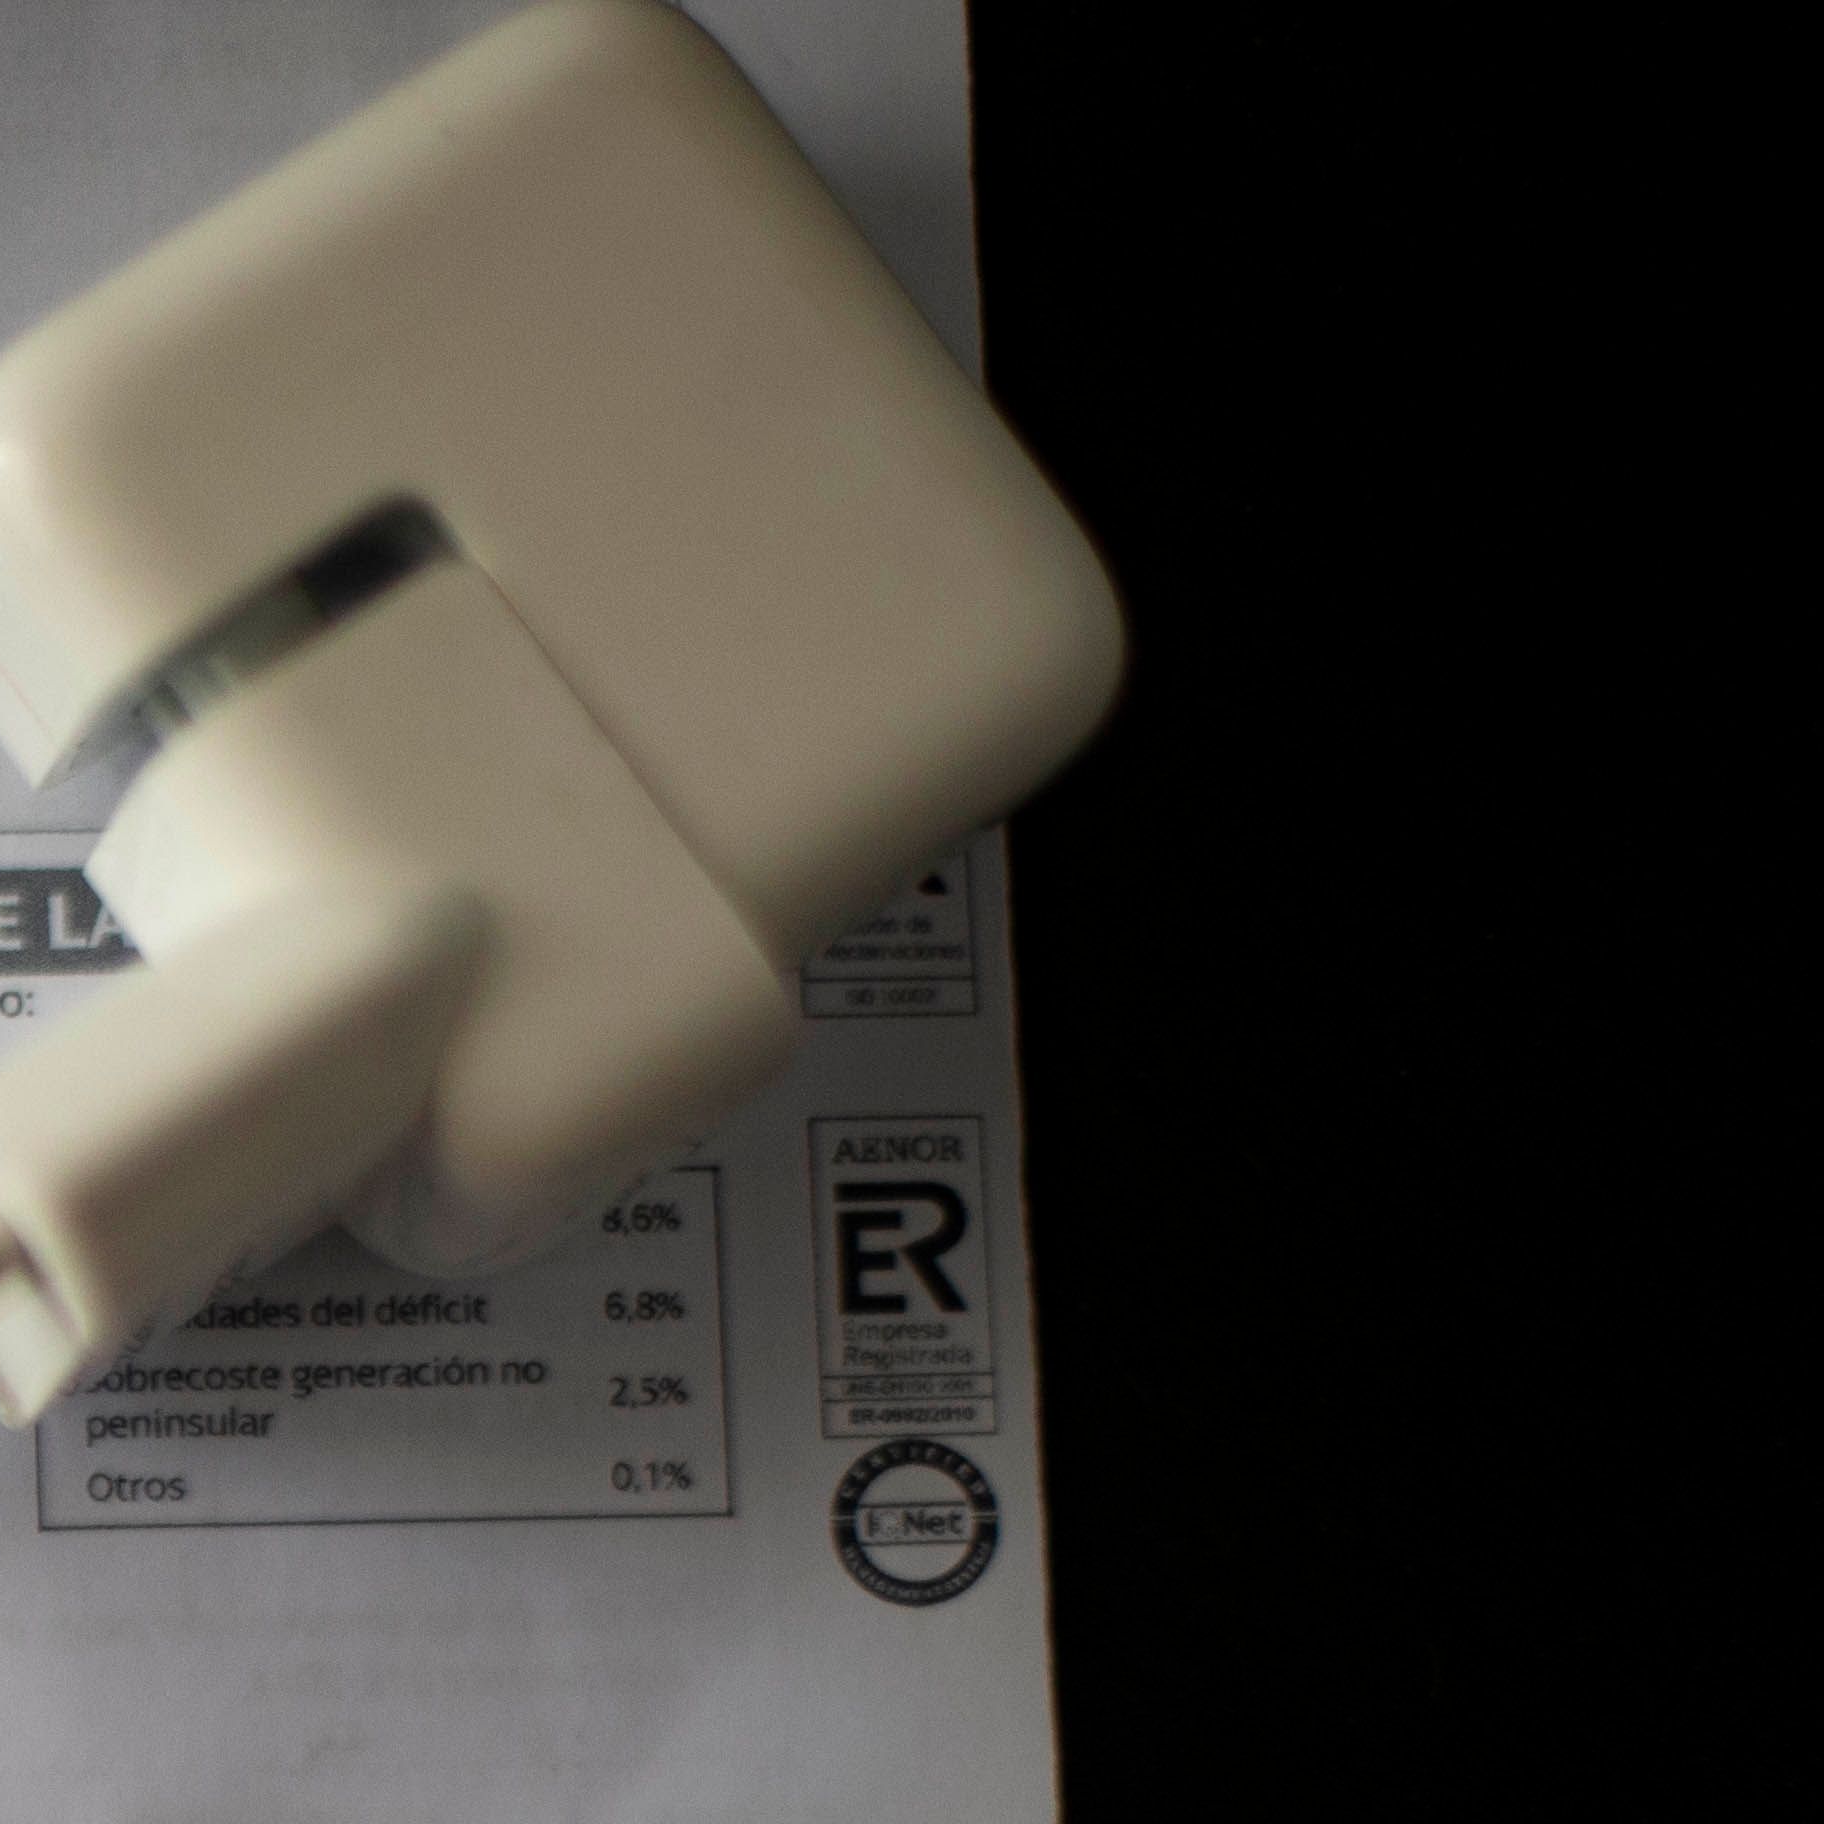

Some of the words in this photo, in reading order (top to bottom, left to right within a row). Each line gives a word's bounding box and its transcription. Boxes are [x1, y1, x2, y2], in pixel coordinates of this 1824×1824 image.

[832, 1134, 964, 1165] AENOR
[310, 1295, 367, 1328] del
[374, 1292, 487, 1327] déficit
[842, 1316, 949, 1346] Empresa
[291, 1356, 492, 1399] generación
[501, 1359, 549, 1385] no
[86, 1405, 275, 1446] peninsular
[86, 1471, 189, 1504] Otros
